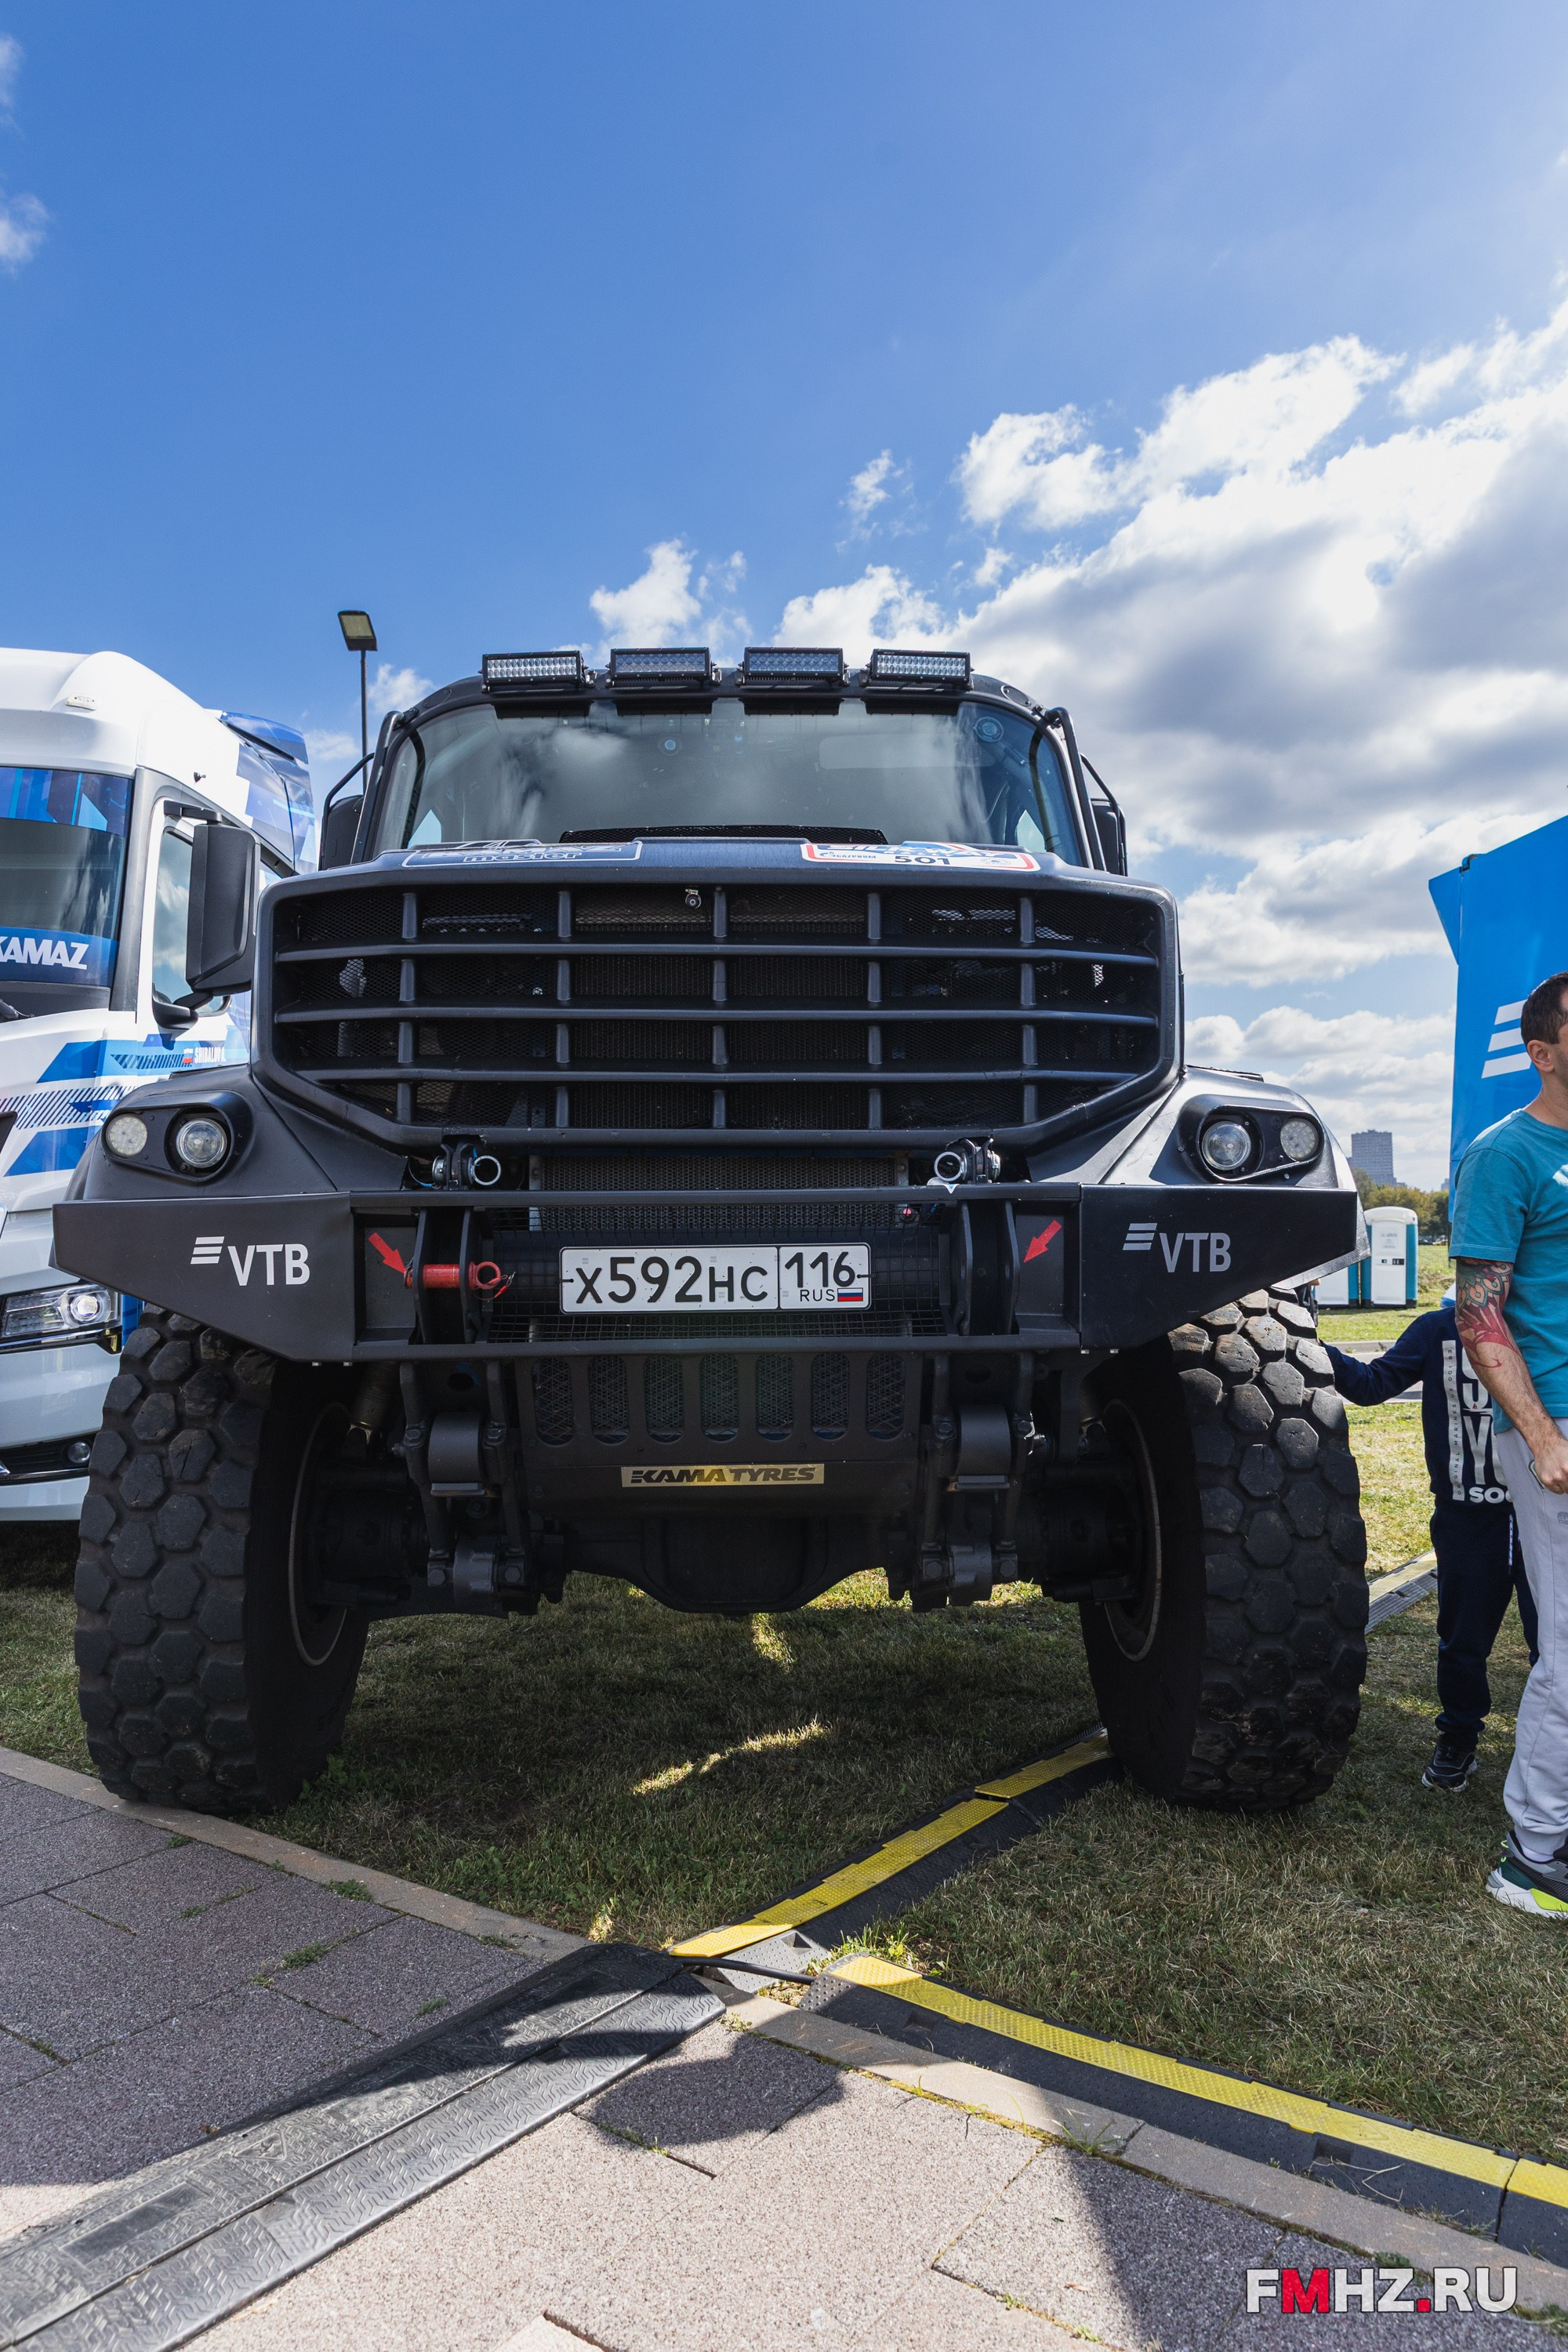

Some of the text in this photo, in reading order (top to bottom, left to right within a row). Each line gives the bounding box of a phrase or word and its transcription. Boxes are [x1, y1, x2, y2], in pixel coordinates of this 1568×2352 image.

[463, 852, 583, 862] master
[895, 855, 951, 866] 501
[1160, 1232, 1232, 1273] VTB
[227, 1243, 310, 1286] VTB
[784, 1251, 855, 1289] 116
[799, 1288, 836, 1302] RUS
[632, 1467, 815, 1483] KAMA TYRES
